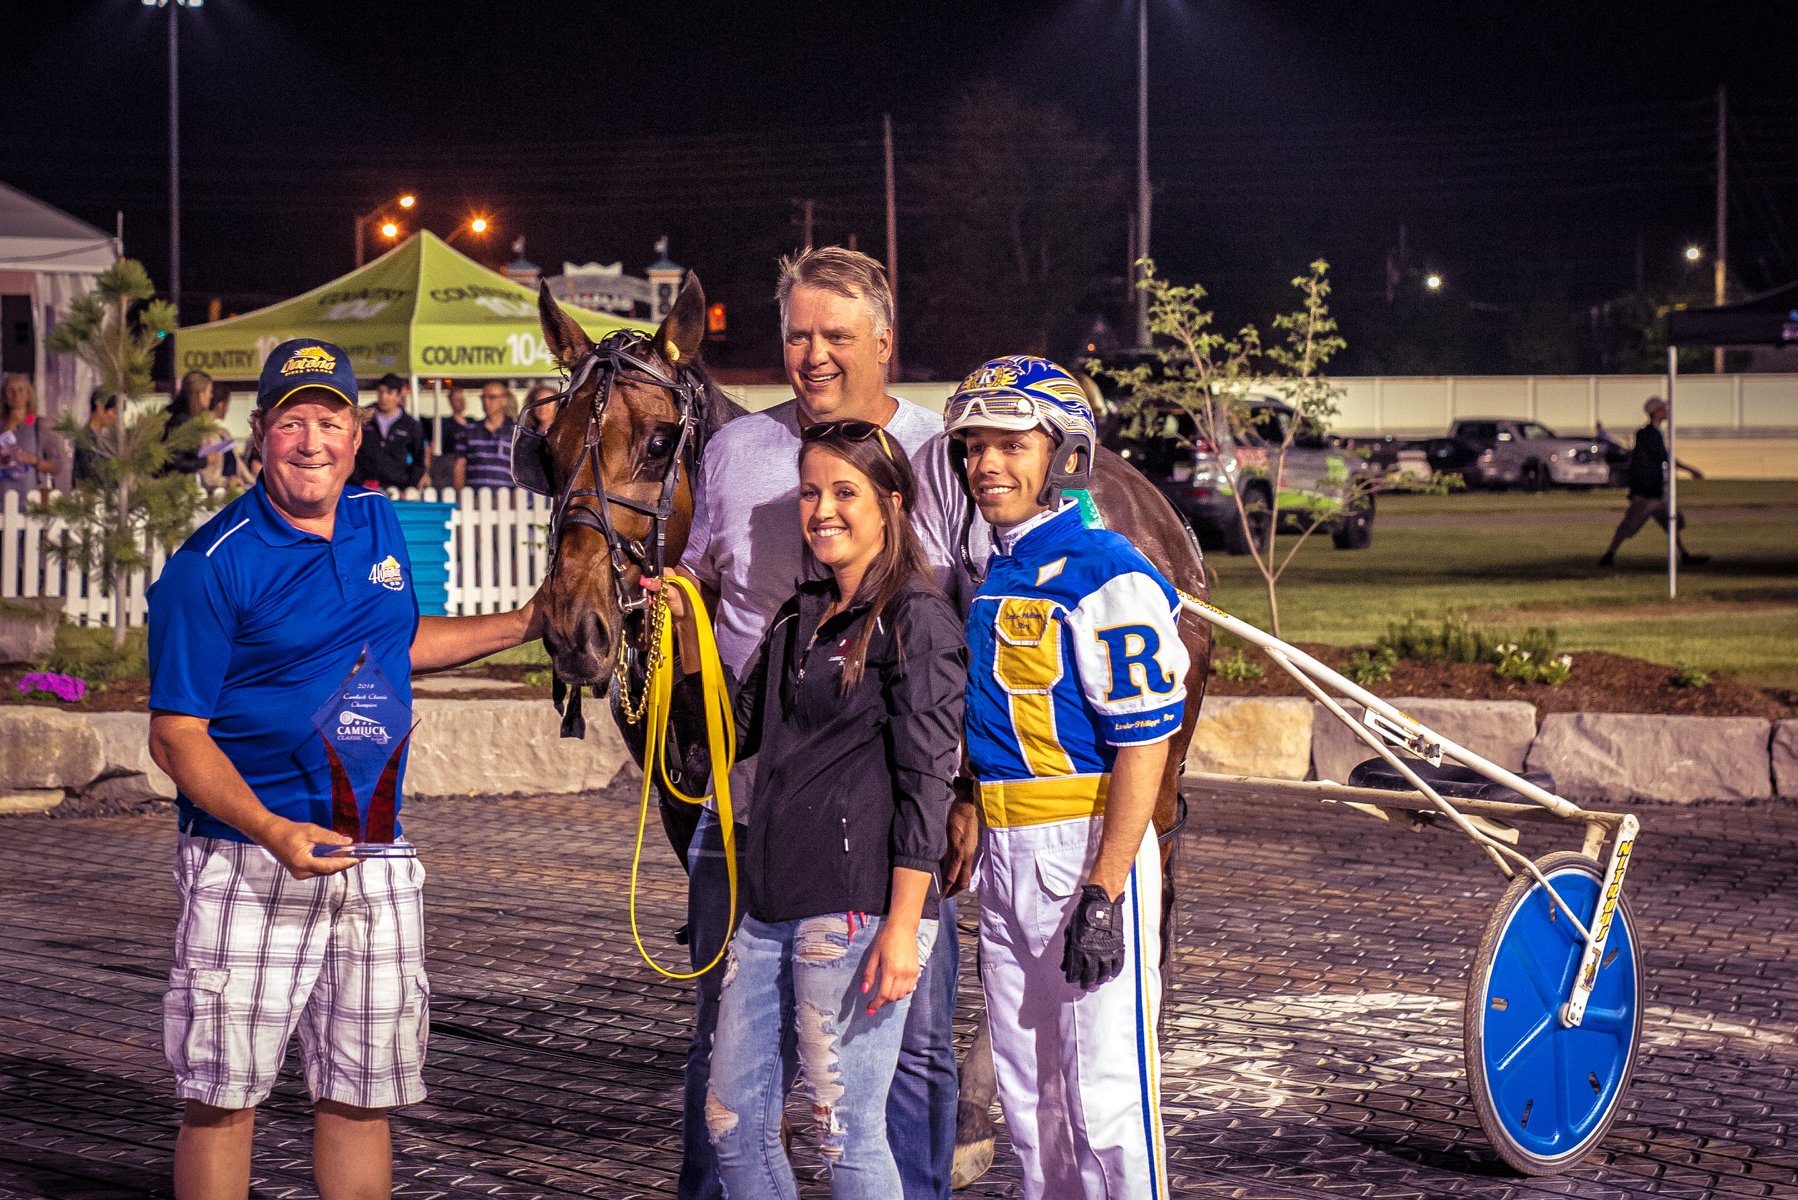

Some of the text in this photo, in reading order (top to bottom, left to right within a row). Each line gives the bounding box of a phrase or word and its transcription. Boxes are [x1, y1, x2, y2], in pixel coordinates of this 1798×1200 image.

[183, 349, 256, 369] COUNTRY
[421, 345, 507, 365] COUNTRY
[368, 562, 385, 585] 40
[1094, 622, 1176, 703] R
[1595, 841, 1634, 942] NITROUS
